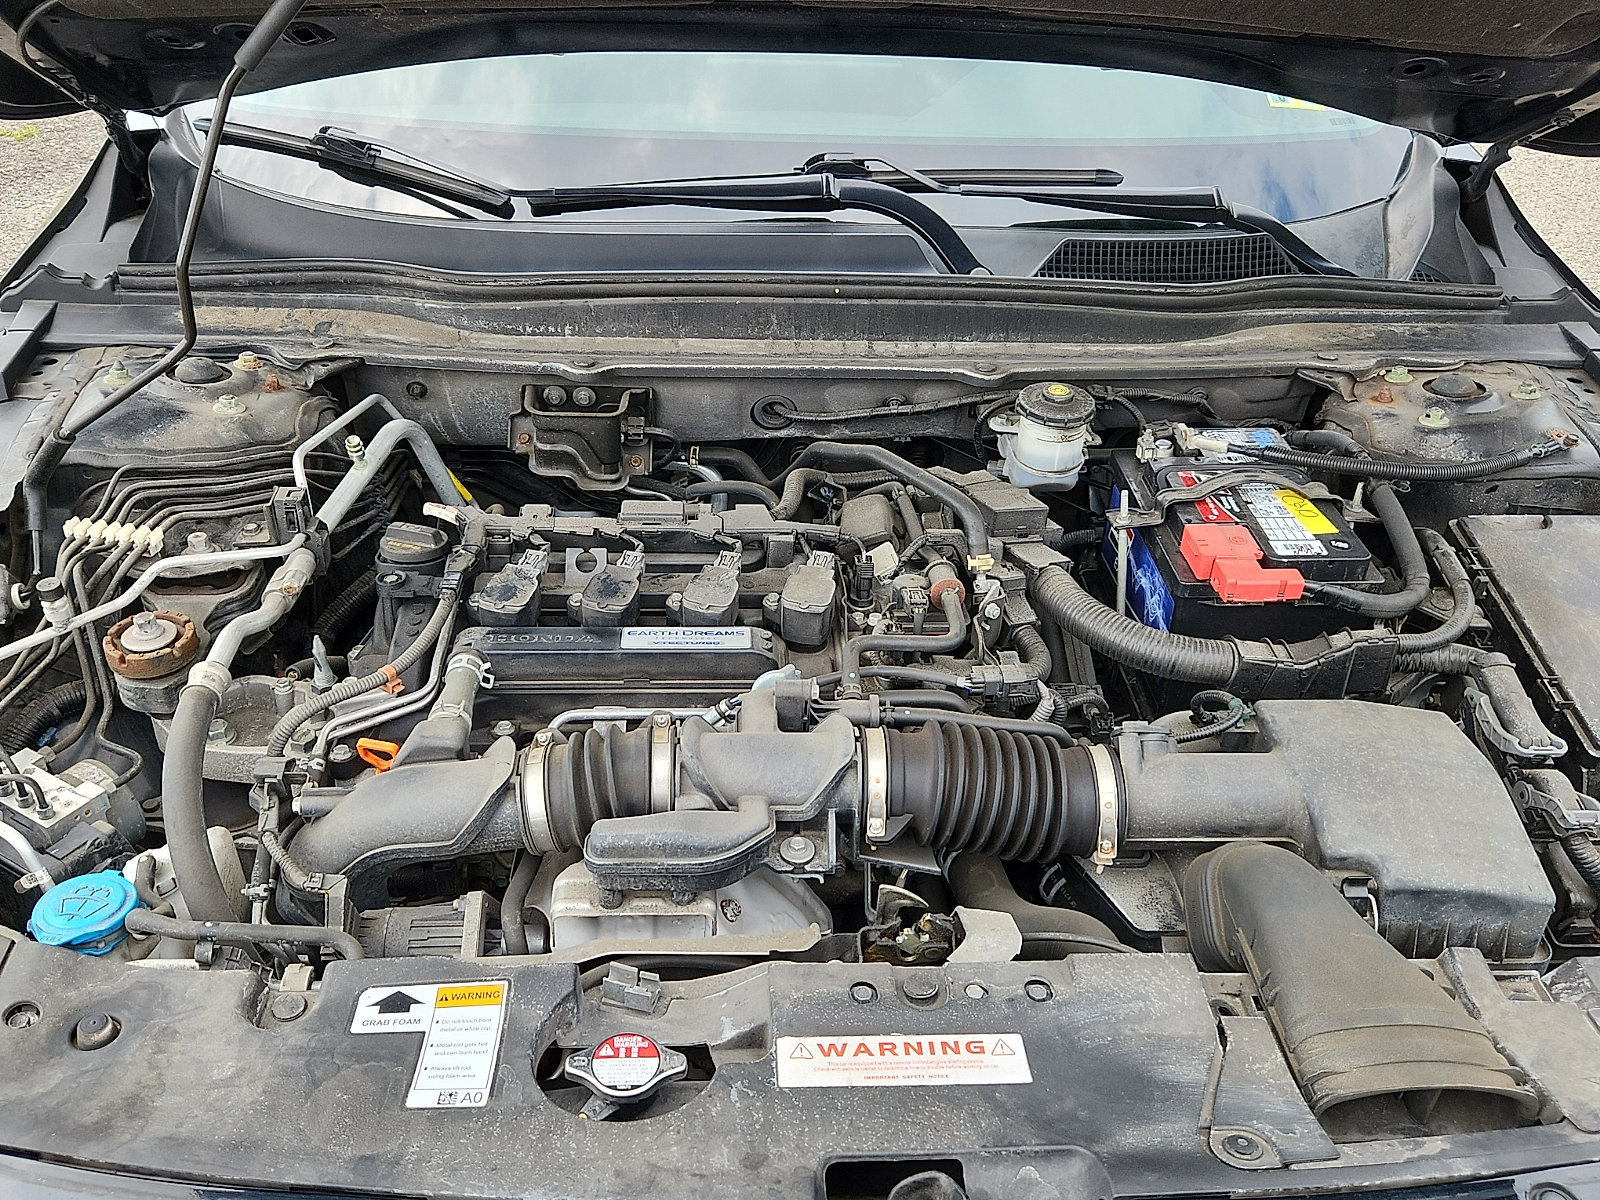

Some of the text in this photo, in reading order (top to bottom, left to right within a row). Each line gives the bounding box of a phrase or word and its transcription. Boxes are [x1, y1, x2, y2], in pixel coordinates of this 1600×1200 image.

[486, 634, 601, 643] HONDA
[451, 991, 500, 1001] WARNING
[361, 1018, 421, 1027] GRAB FOAM
[816, 1040, 986, 1057] WARNING
[460, 1091, 483, 1104] A0
